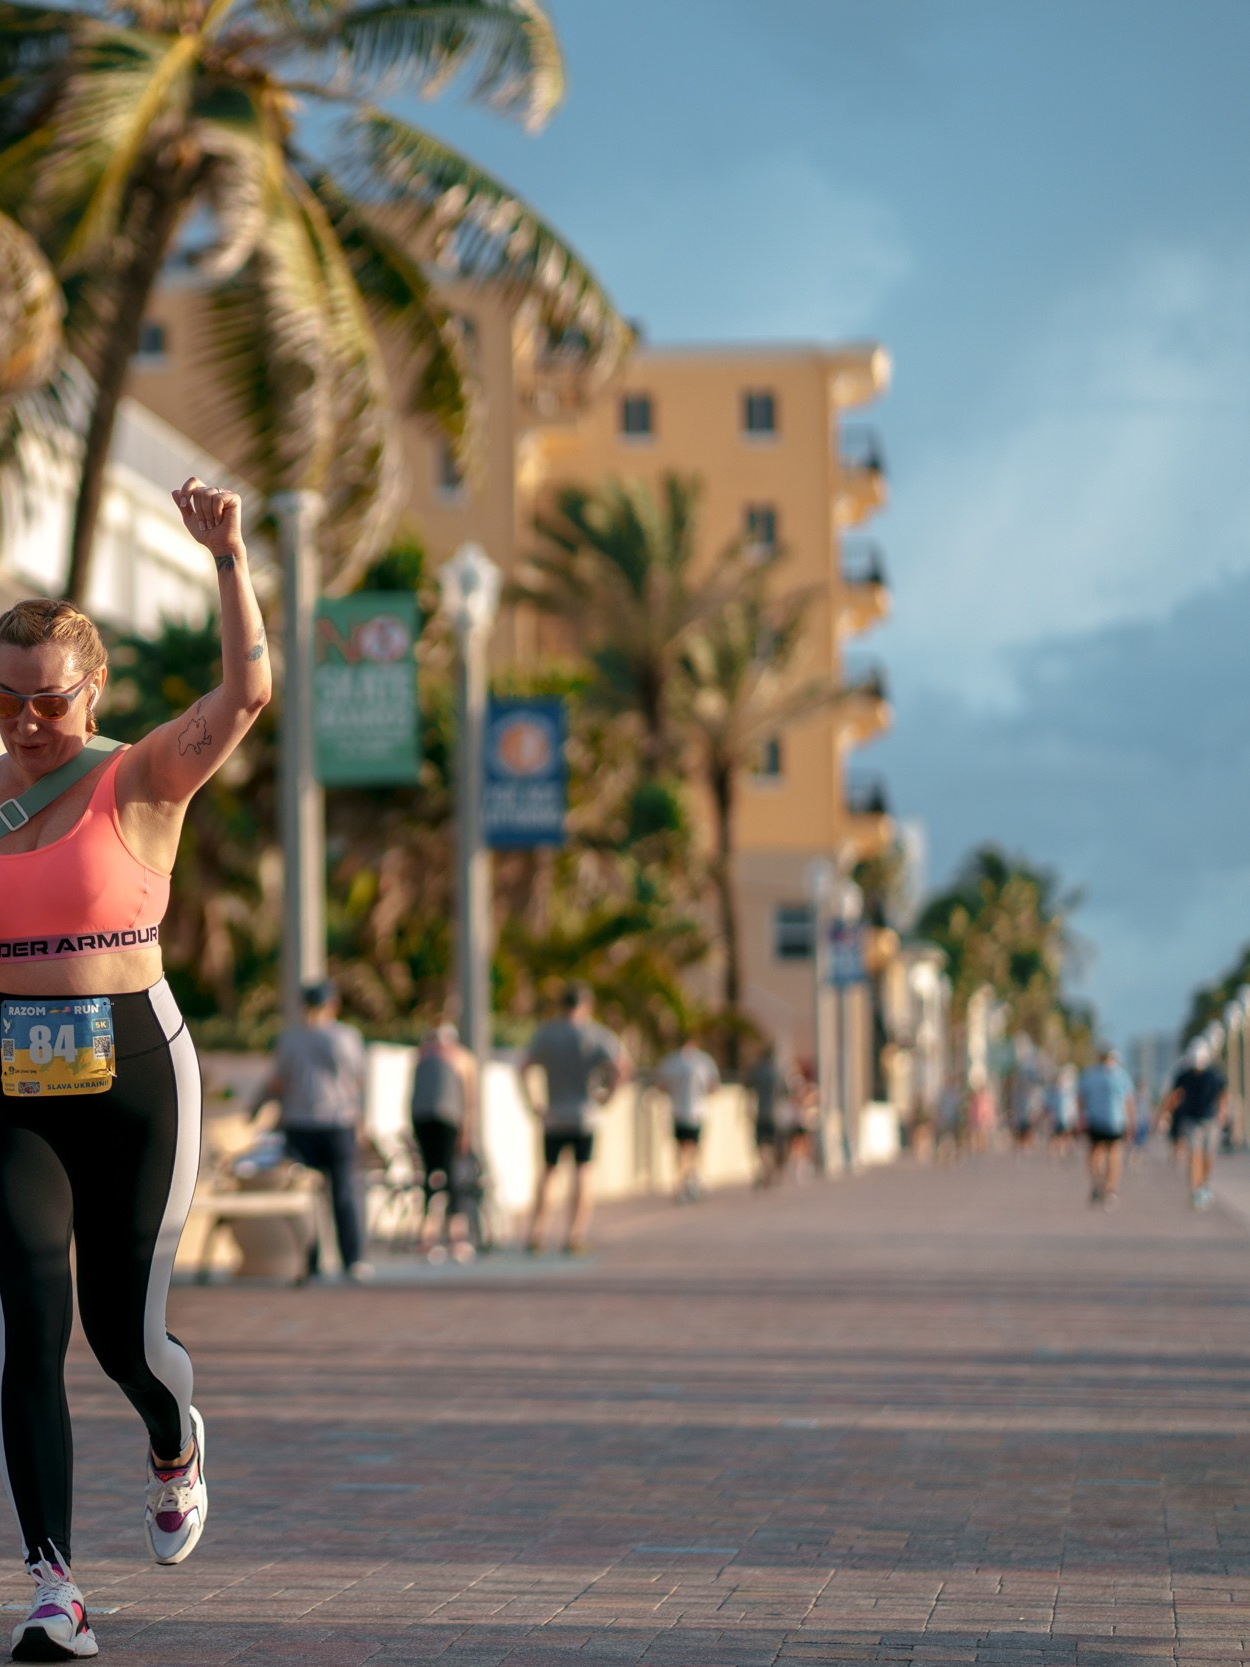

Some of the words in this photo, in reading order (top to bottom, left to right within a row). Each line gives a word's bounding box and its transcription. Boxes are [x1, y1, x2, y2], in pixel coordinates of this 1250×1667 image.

[55, 926, 158, 954] ARMOUR
[8, 1006, 46, 1016] RAZOM
[74, 1004, 100, 1015] RUN
[95, 1021, 107, 1029] 5K
[29, 1024, 78, 1065] 84
